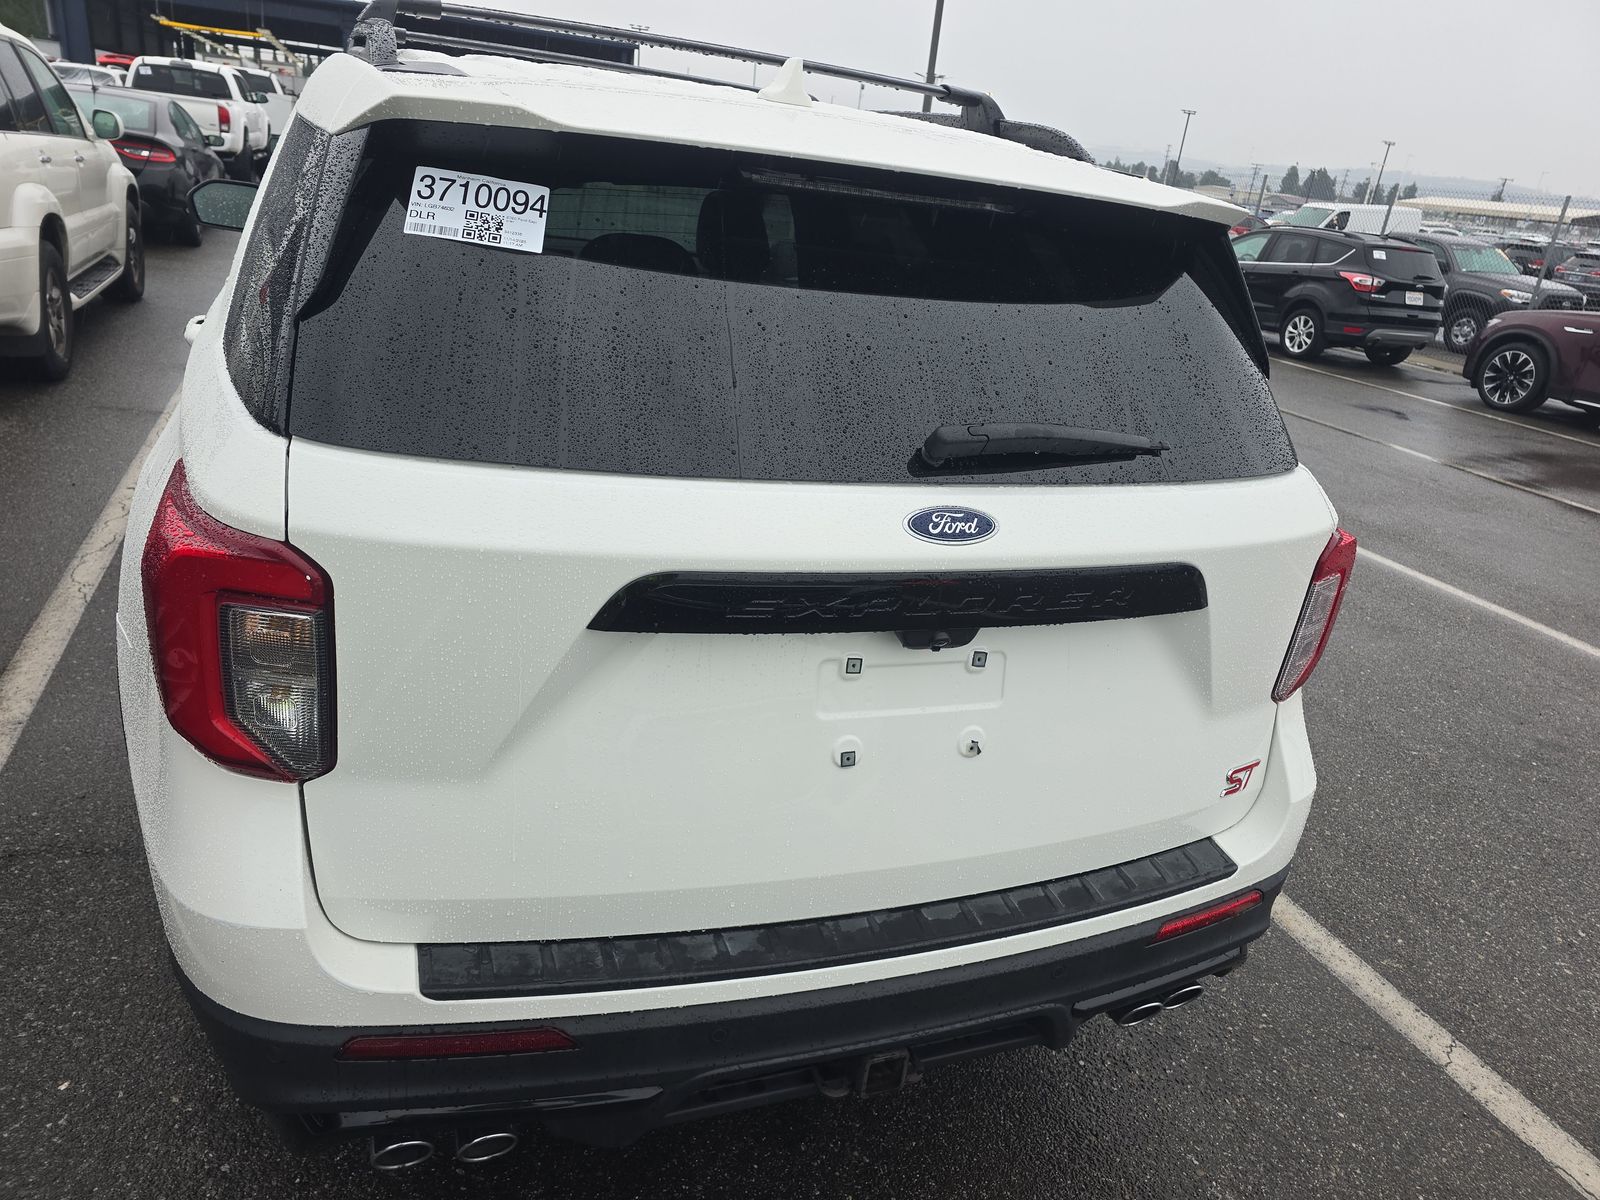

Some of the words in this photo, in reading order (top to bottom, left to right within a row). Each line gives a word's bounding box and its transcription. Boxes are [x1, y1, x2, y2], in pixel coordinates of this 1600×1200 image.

[482, 178, 506, 187] California
[417, 174, 546, 218] 3710094
[409, 209, 435, 220] DLR
[928, 512, 979, 534] Ford
[725, 589, 1134, 619] EXPLORER
[1220, 759, 1261, 797] ST
